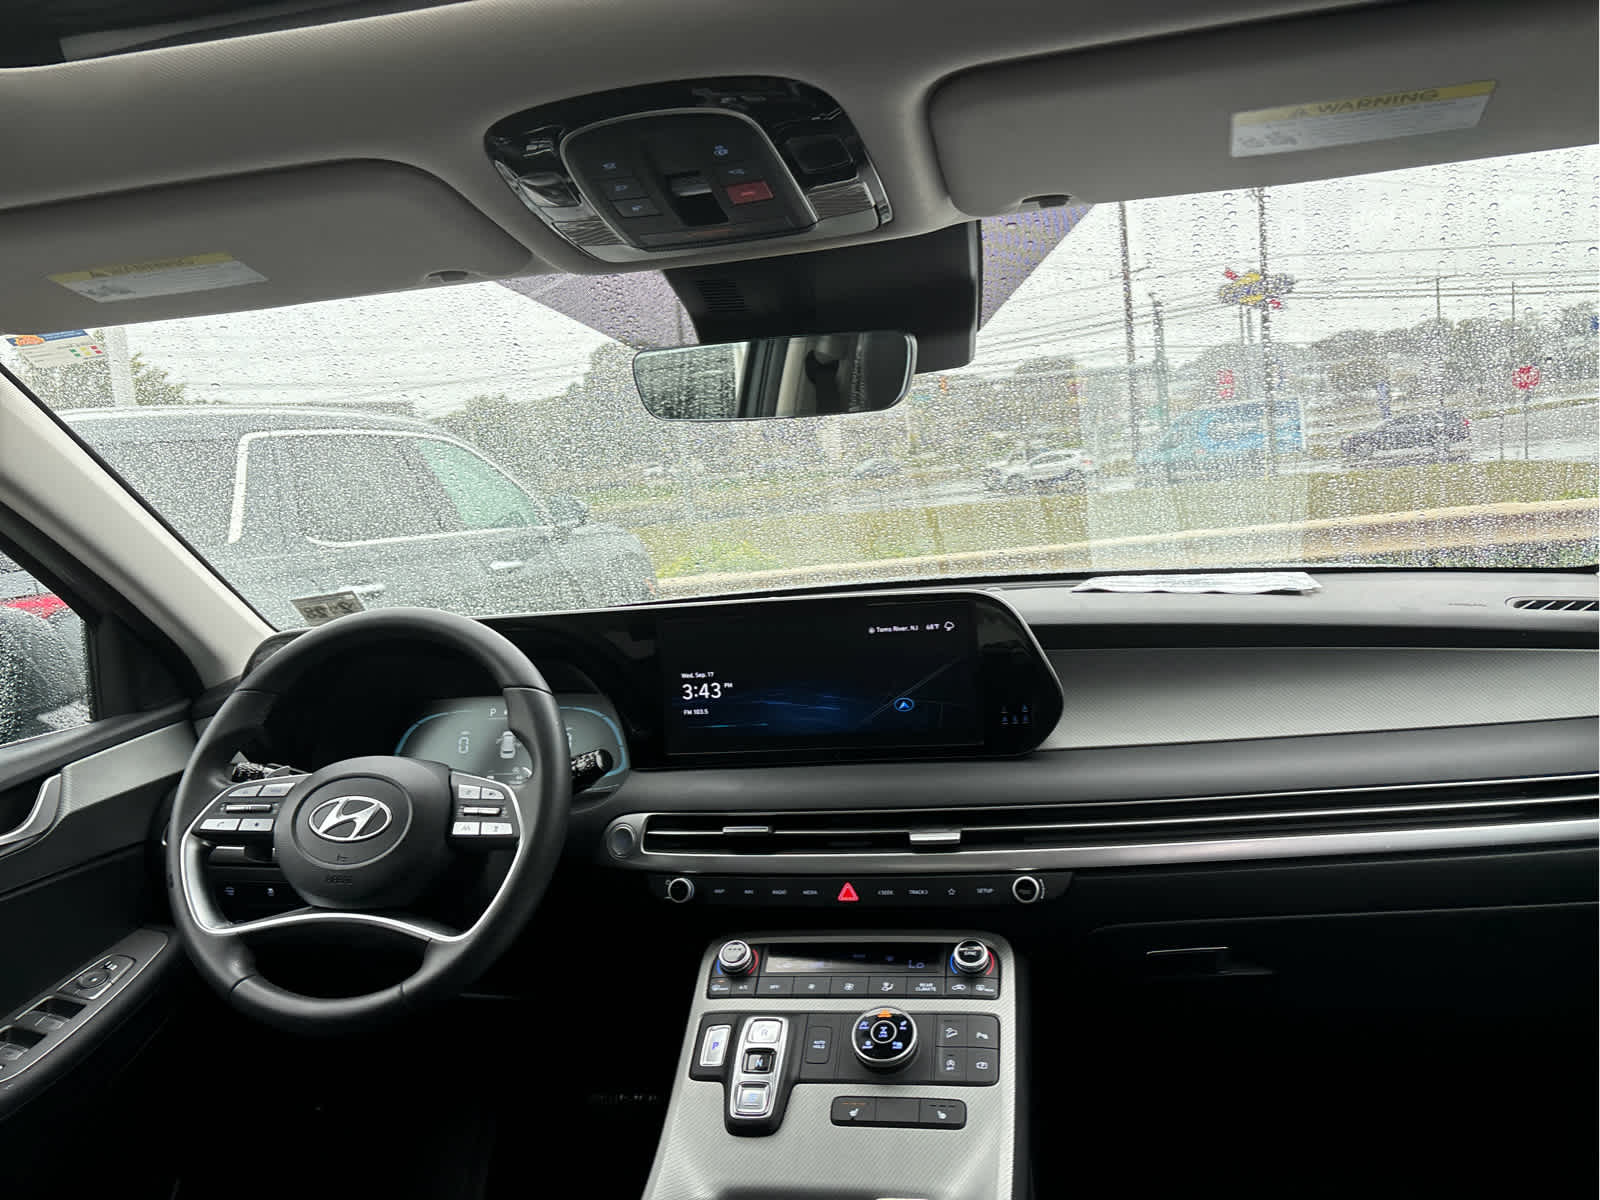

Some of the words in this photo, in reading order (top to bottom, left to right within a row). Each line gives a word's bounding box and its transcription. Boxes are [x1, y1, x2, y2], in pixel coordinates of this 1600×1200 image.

[1317, 89, 1440, 113] WARNING
[682, 682, 722, 700] 3:43
[489, 707, 497, 717] P
[711, 1041, 719, 1050] P
